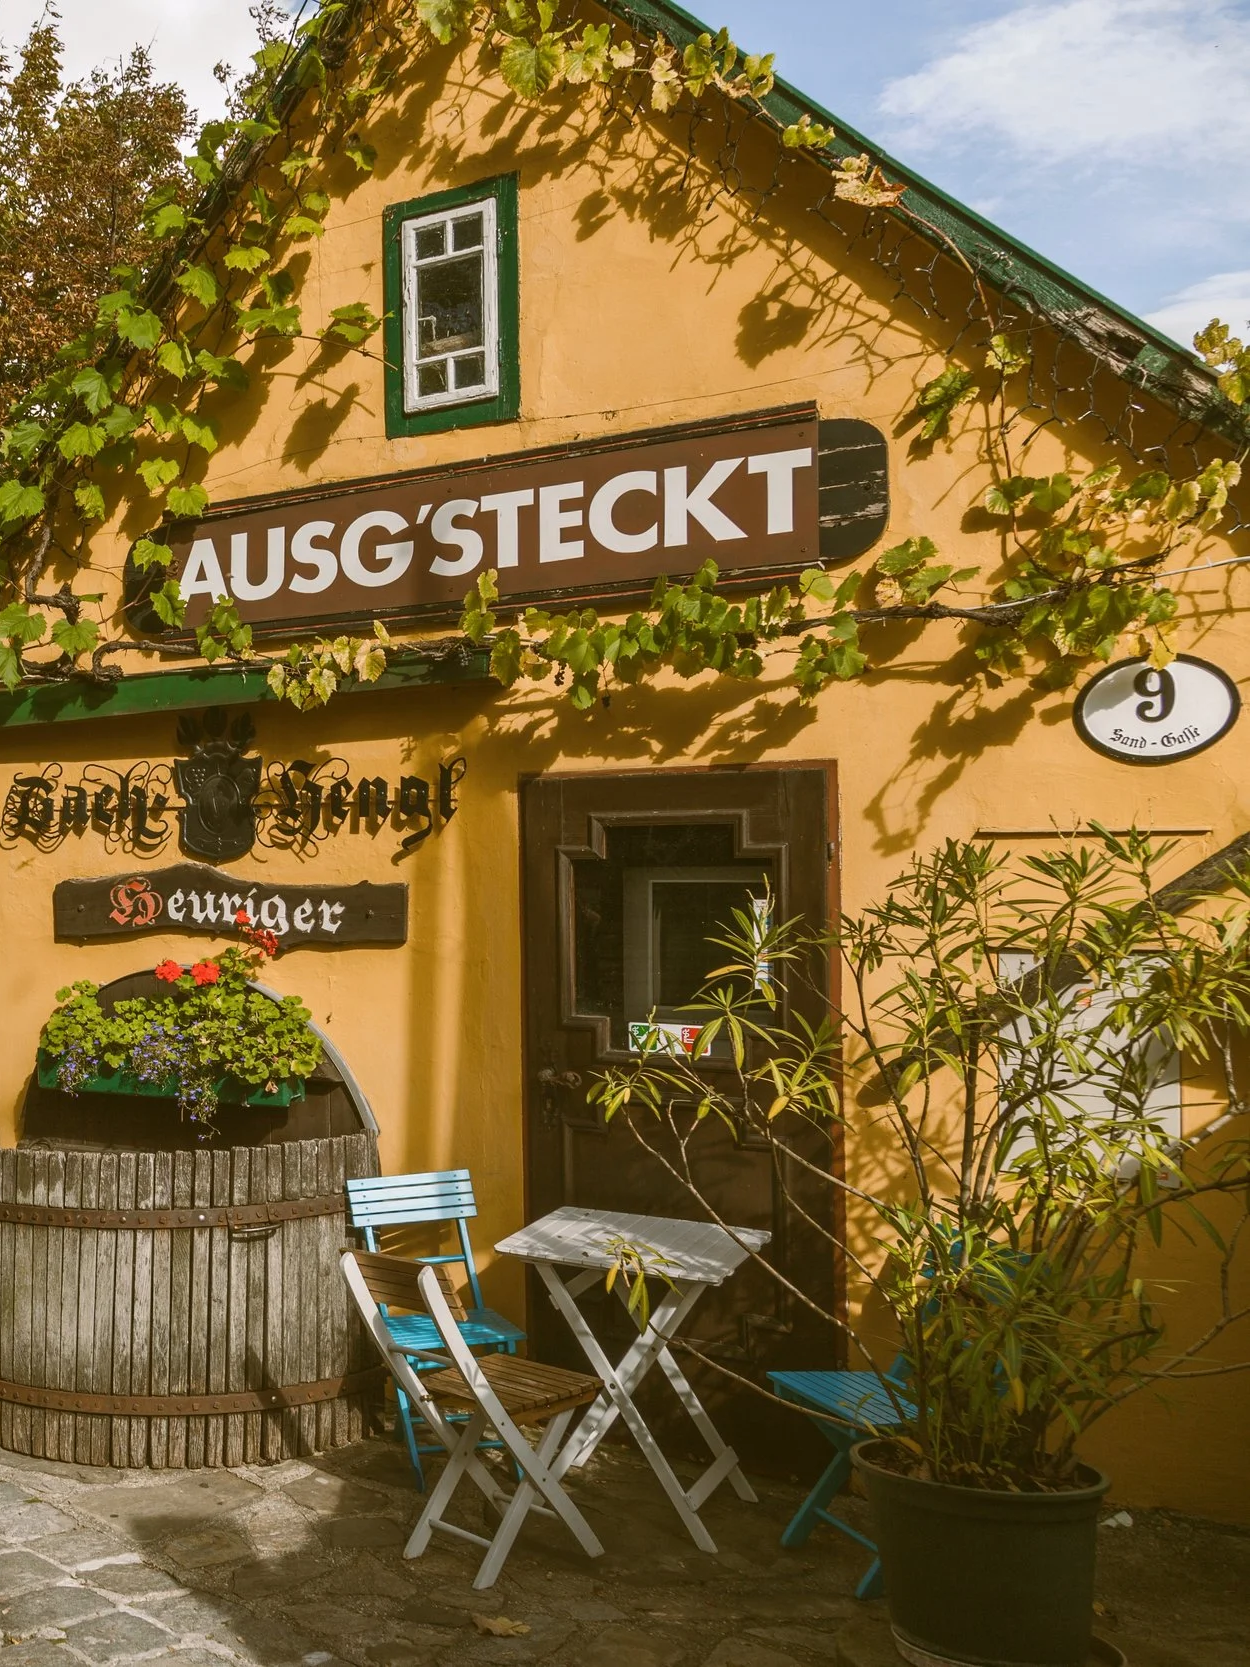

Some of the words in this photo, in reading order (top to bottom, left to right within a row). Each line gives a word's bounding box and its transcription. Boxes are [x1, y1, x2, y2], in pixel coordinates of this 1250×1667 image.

[1133, 666, 1176, 723] 9
[1110, 728, 1147, 749] Sand
[109, 876, 346, 936] Heuriger
